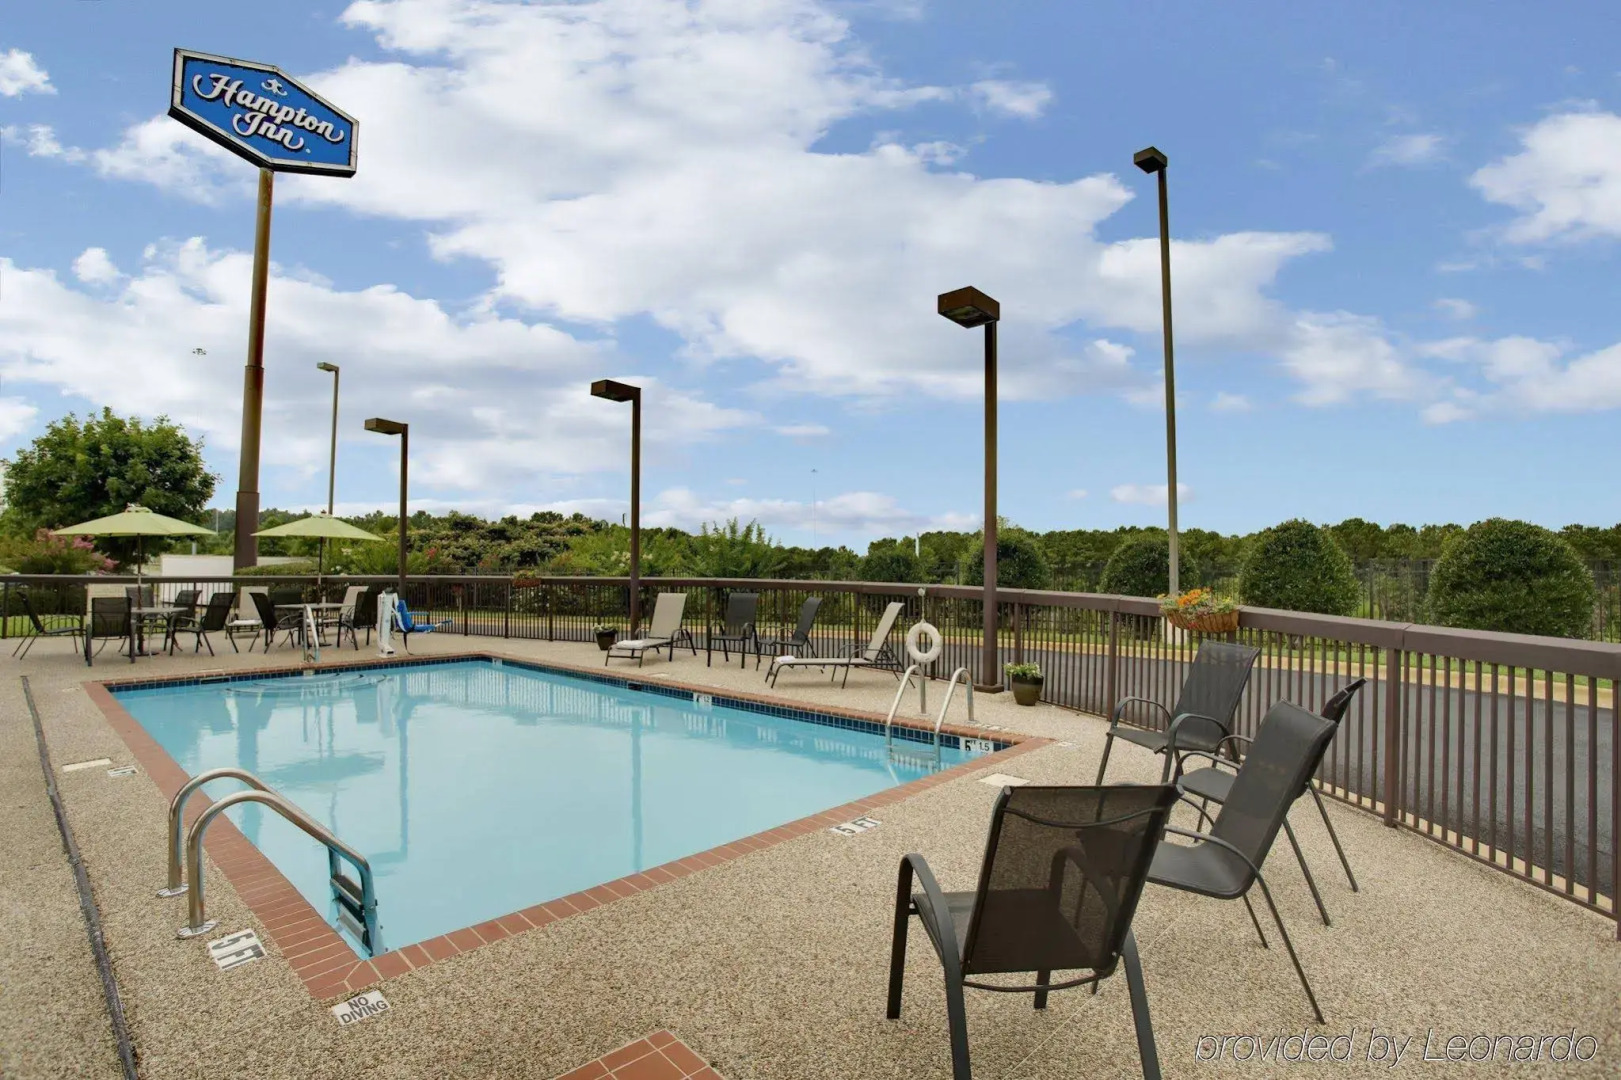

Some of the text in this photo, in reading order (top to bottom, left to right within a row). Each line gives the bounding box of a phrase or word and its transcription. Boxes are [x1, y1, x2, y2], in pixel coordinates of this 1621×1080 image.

[193, 73, 344, 143] Hampton
[232, 111, 304, 150] Inn
[340, 1000, 389, 1024] DIVING
[347, 996, 369, 1010] NO
